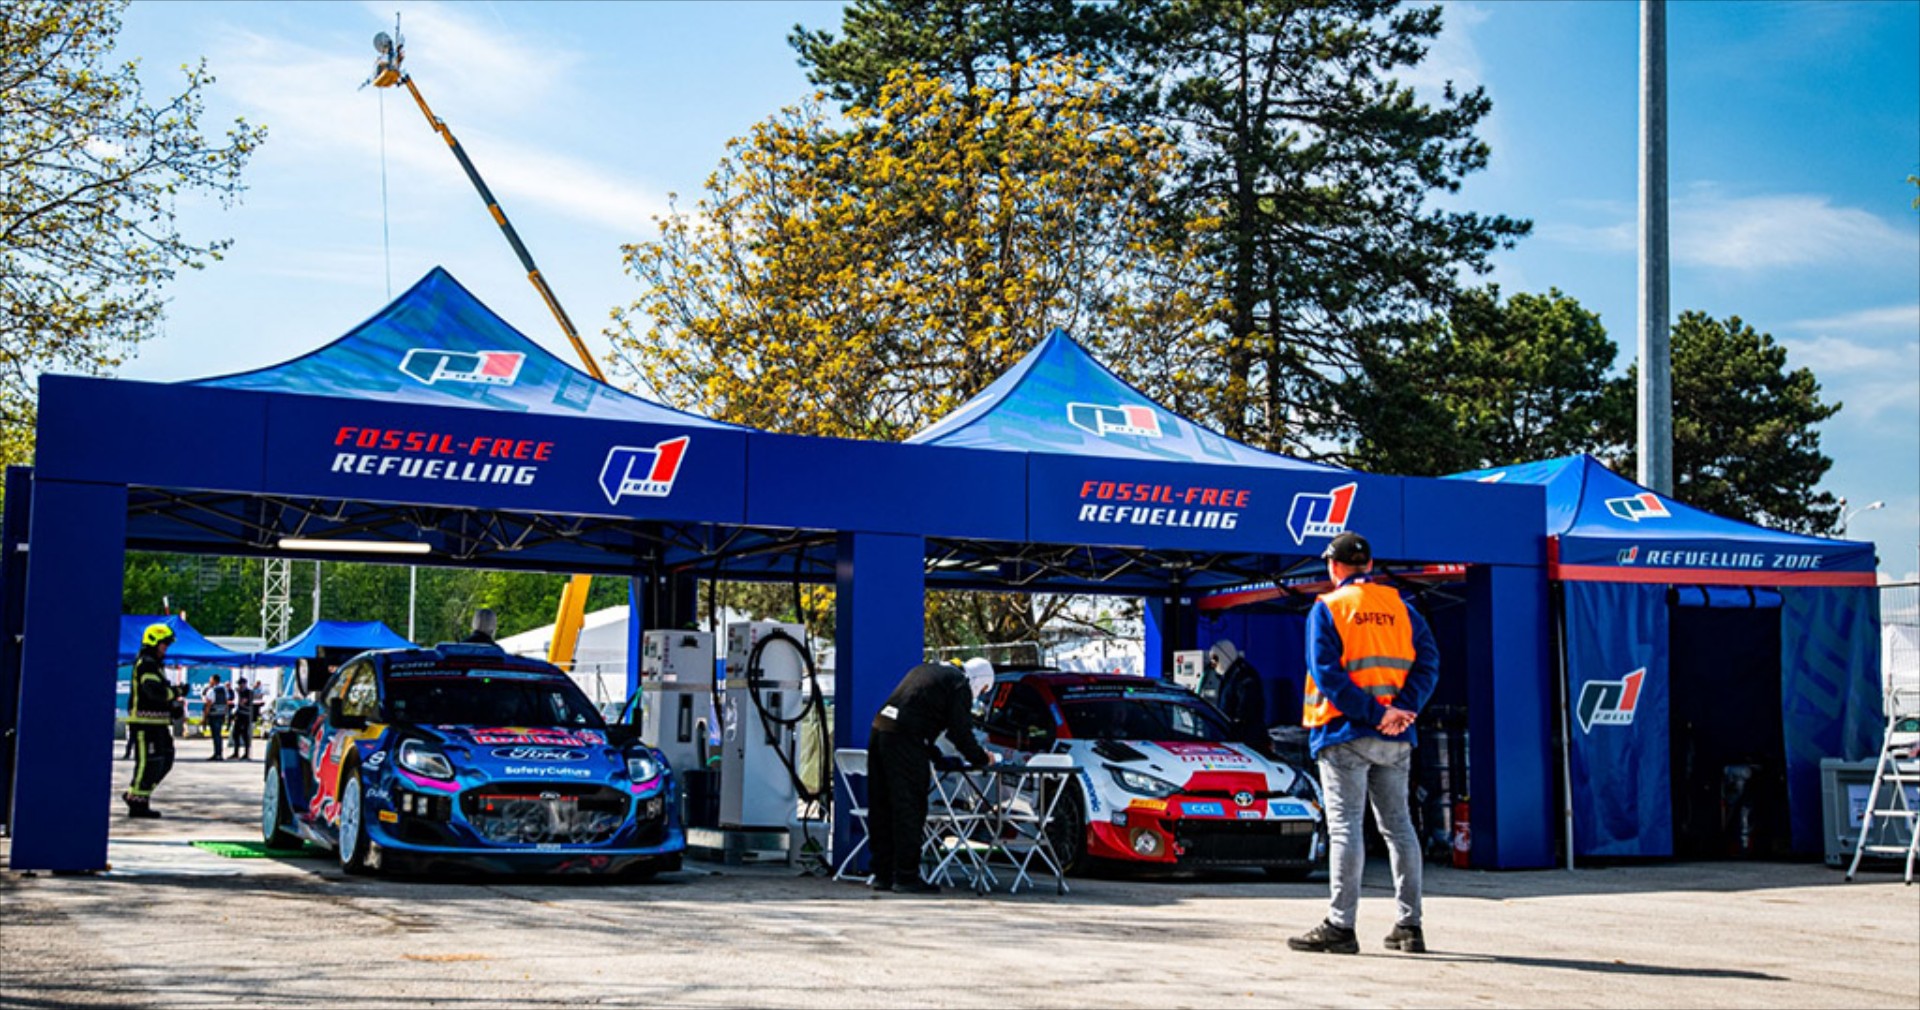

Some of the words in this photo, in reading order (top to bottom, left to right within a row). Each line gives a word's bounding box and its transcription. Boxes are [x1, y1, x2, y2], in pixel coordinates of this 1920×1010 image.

[334, 427, 554, 461] FOSSIL-FREE
[331, 453, 538, 485] REFUELLING
[1080, 480, 1251, 508] FOSSIL-FREE
[1078, 504, 1239, 529] REFUELLING
[1646, 550, 1764, 568] REFUELLING
[1772, 554, 1823, 569] ZONE
[1354, 612, 1395, 626] SAFETY
[509, 747, 572, 760] Ford
[505, 766, 591, 776] SafetyCulture
